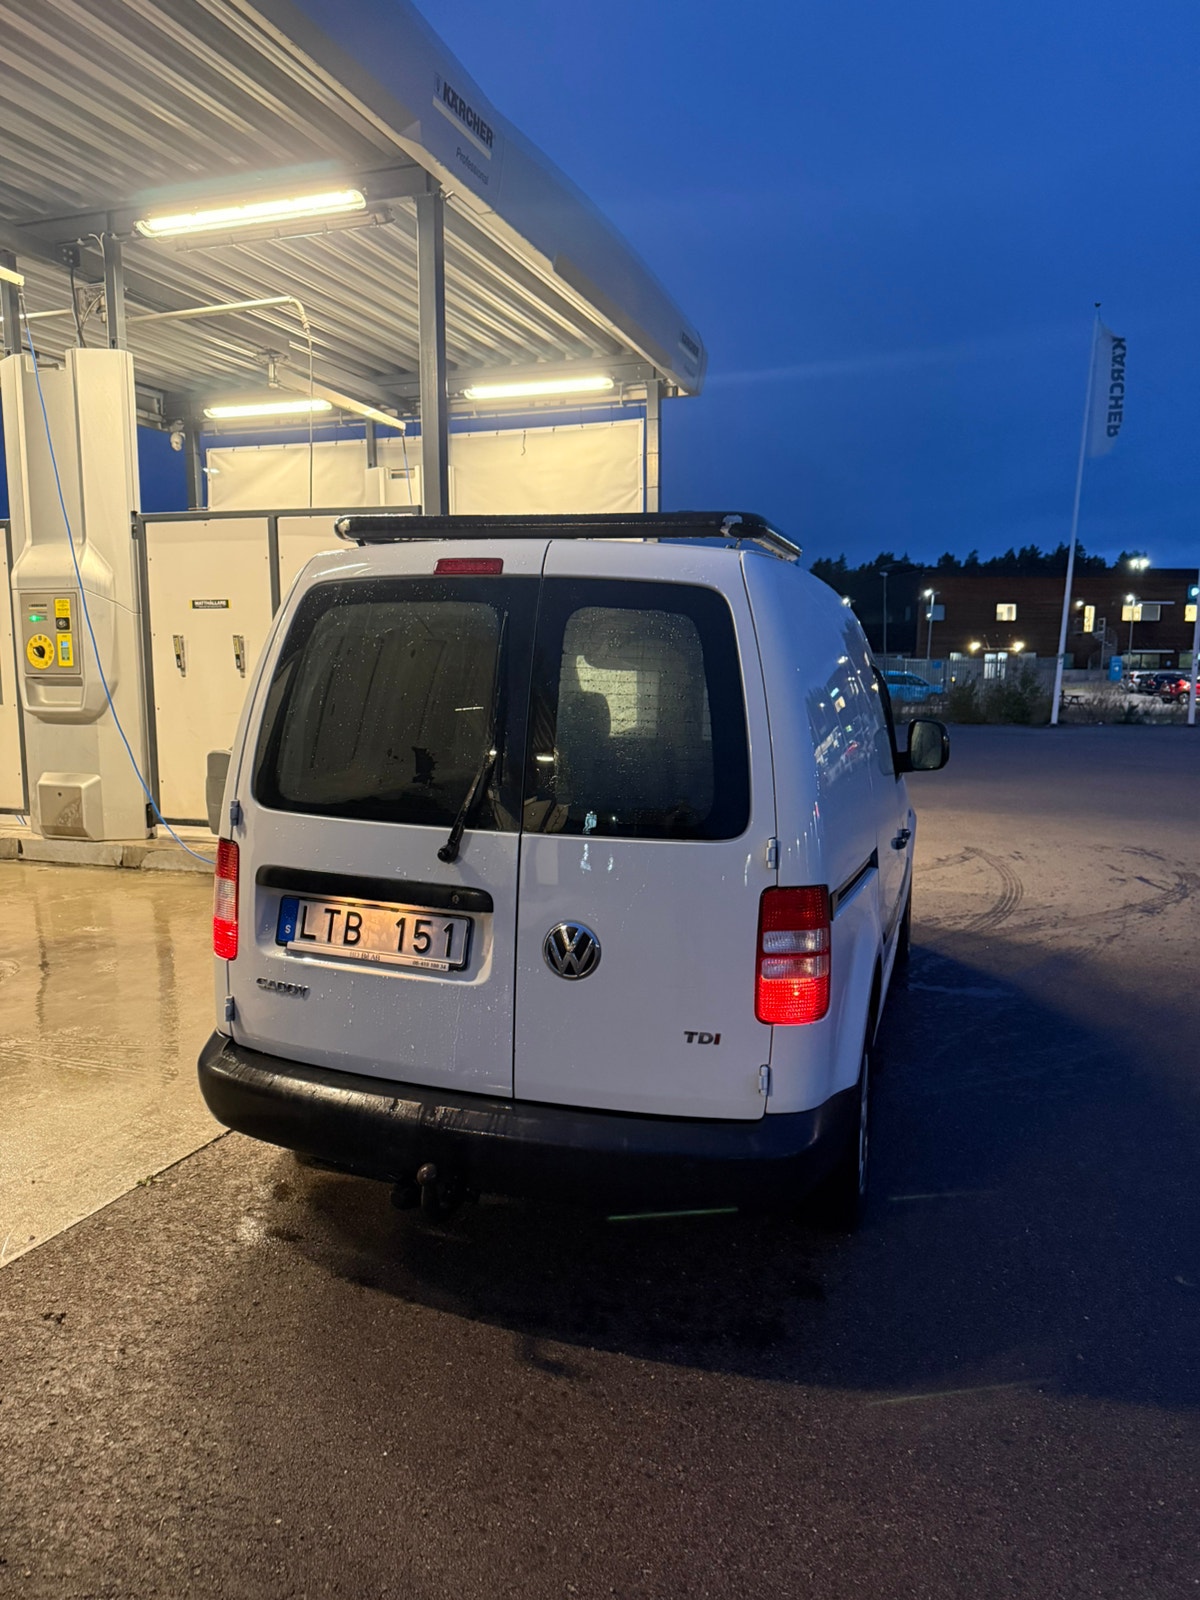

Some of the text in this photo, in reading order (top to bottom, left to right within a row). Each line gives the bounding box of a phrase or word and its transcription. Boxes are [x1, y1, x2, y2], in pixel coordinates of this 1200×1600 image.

[443, 81, 494, 148] KÄRCHER
[284, 924, 292, 934] S
[300, 905, 454, 958] LTB 151
[256, 977, 310, 1001] CADDY
[683, 1031, 721, 1045] TDI
